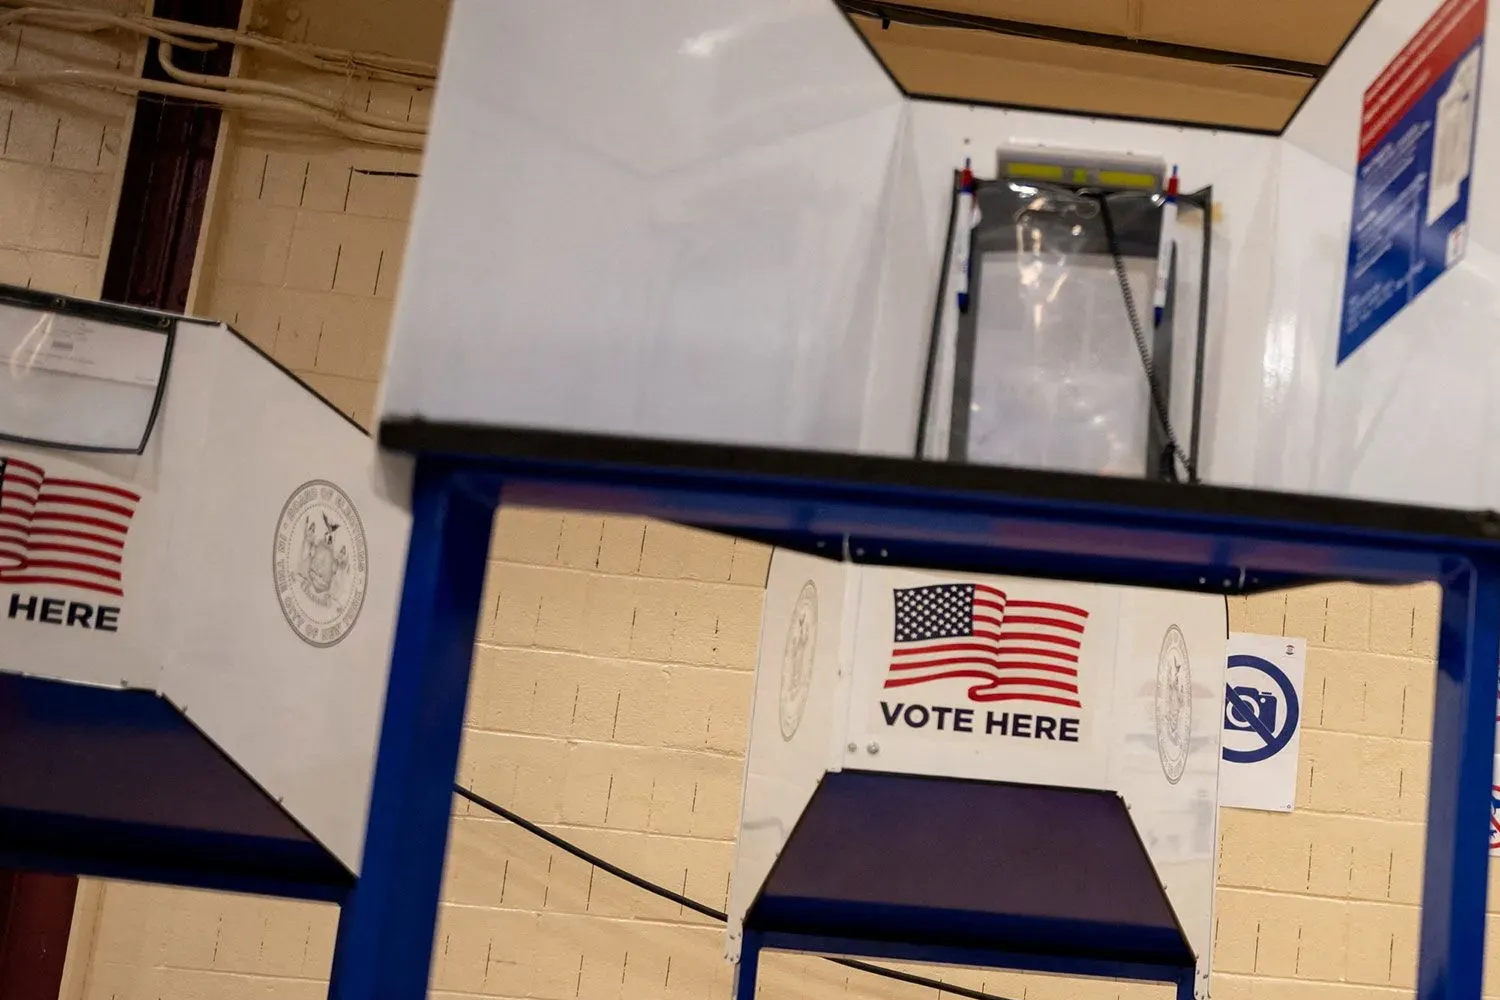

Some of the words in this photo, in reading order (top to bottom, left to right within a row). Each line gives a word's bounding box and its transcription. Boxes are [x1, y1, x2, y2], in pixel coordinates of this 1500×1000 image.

[7, 593, 121, 633] HERE
[879, 701, 973, 734] VOTE
[984, 711, 1081, 742] HERE
